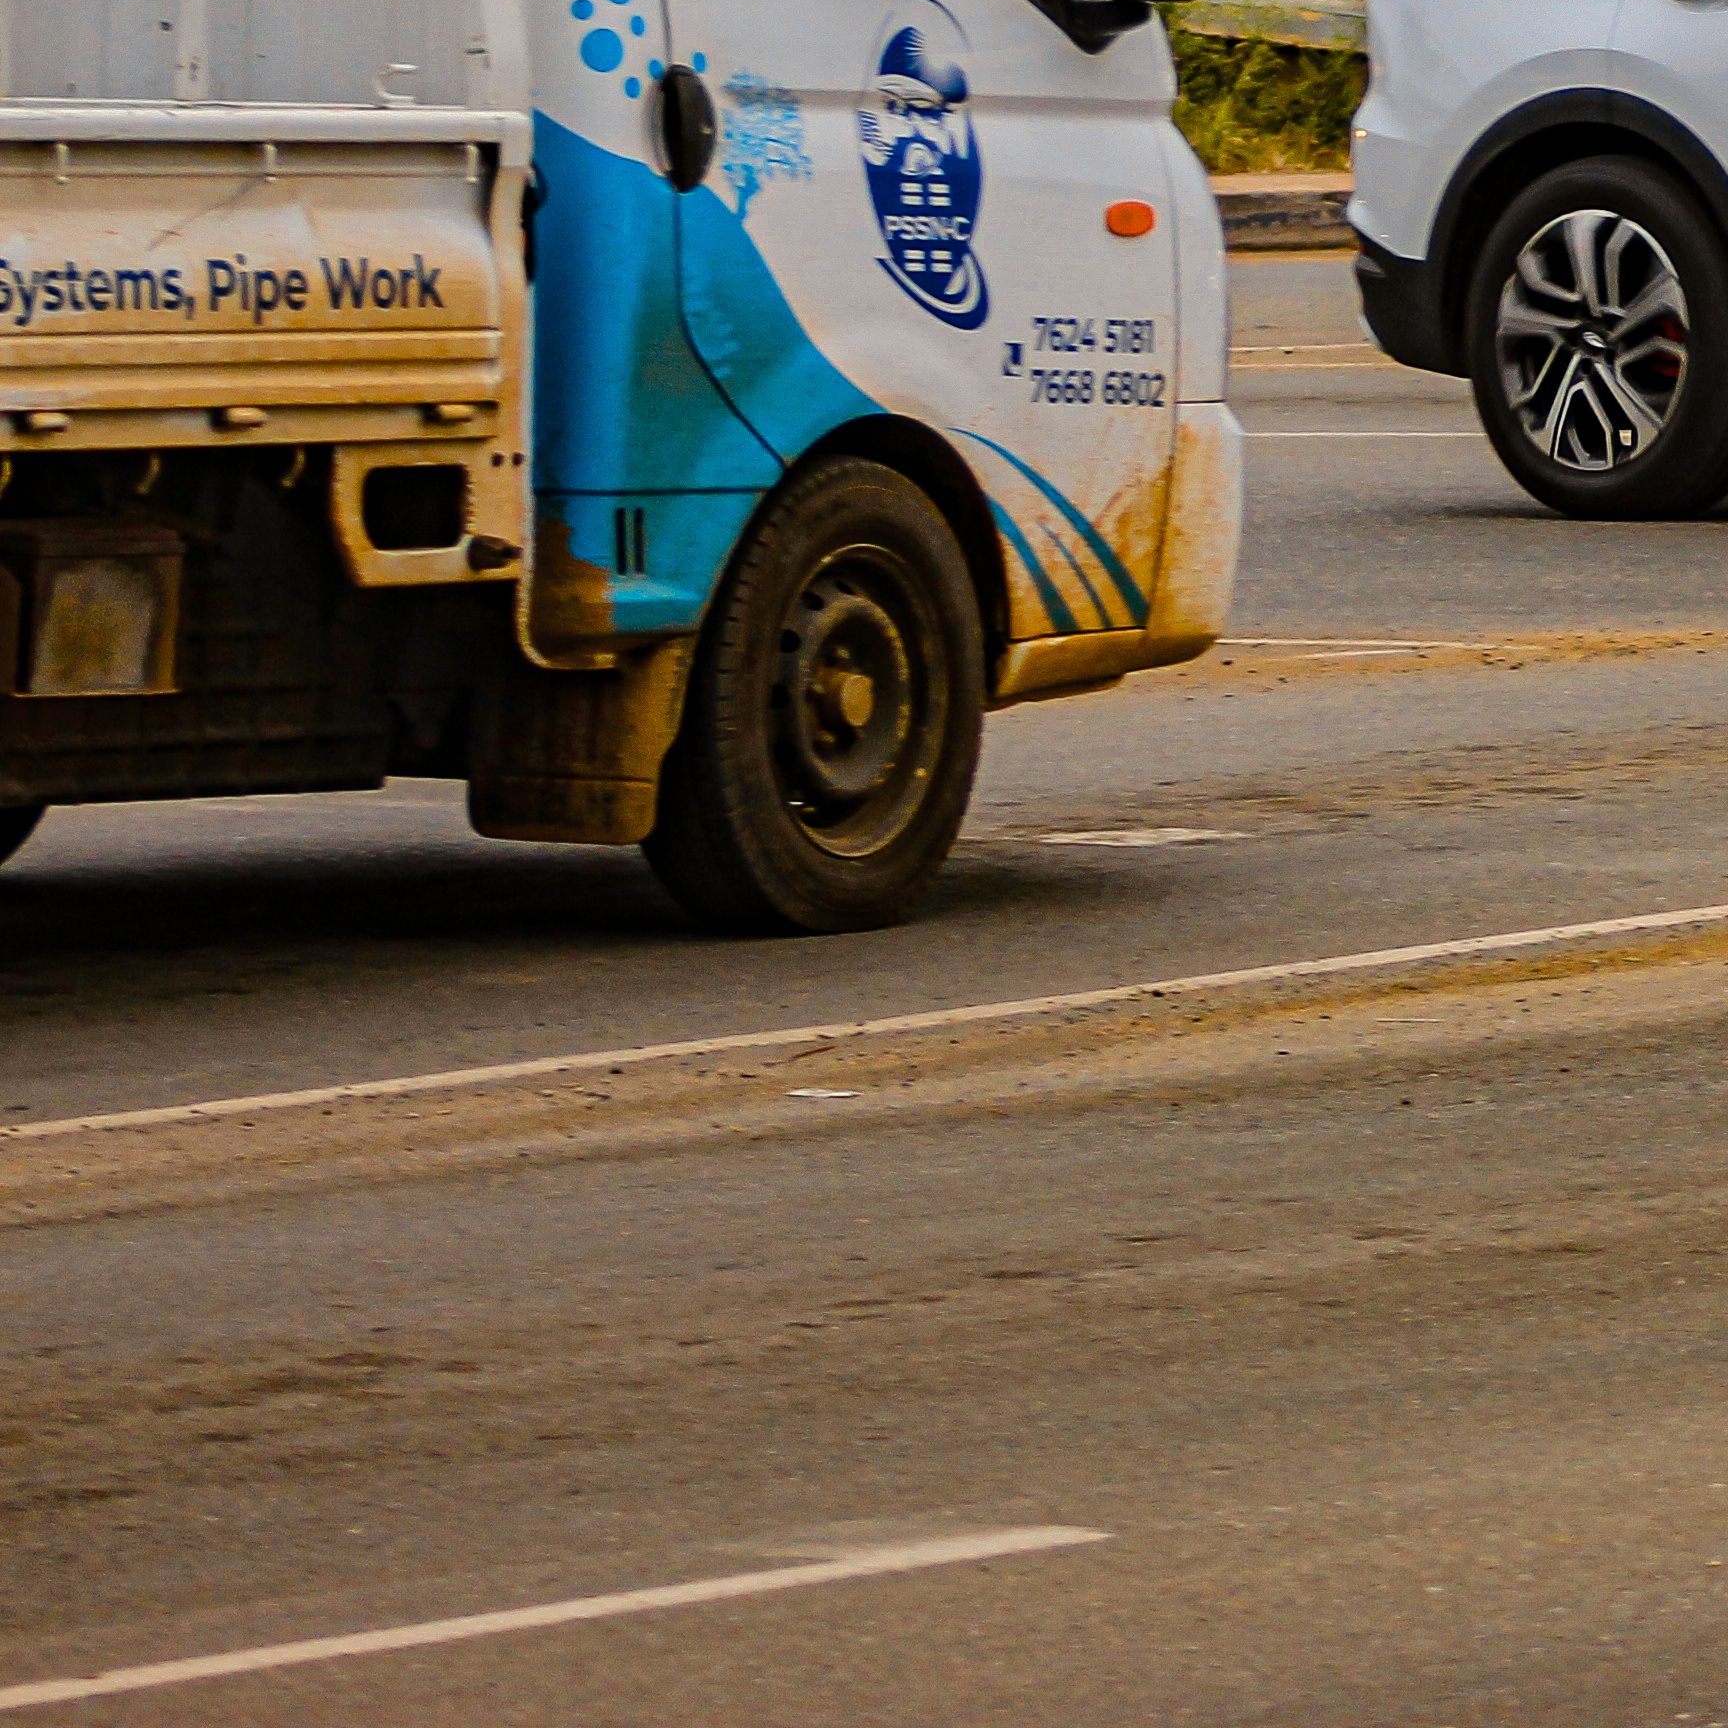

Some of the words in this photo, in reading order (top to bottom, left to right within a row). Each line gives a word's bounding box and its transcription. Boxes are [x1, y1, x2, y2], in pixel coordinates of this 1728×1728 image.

[206, 253, 309, 325] Pipe
[319, 254, 445, 310] Work
[1032, 316, 1096, 352] 7624
[1030, 369, 1094, 405] 7668
[1102, 370, 1166, 408] 6802
